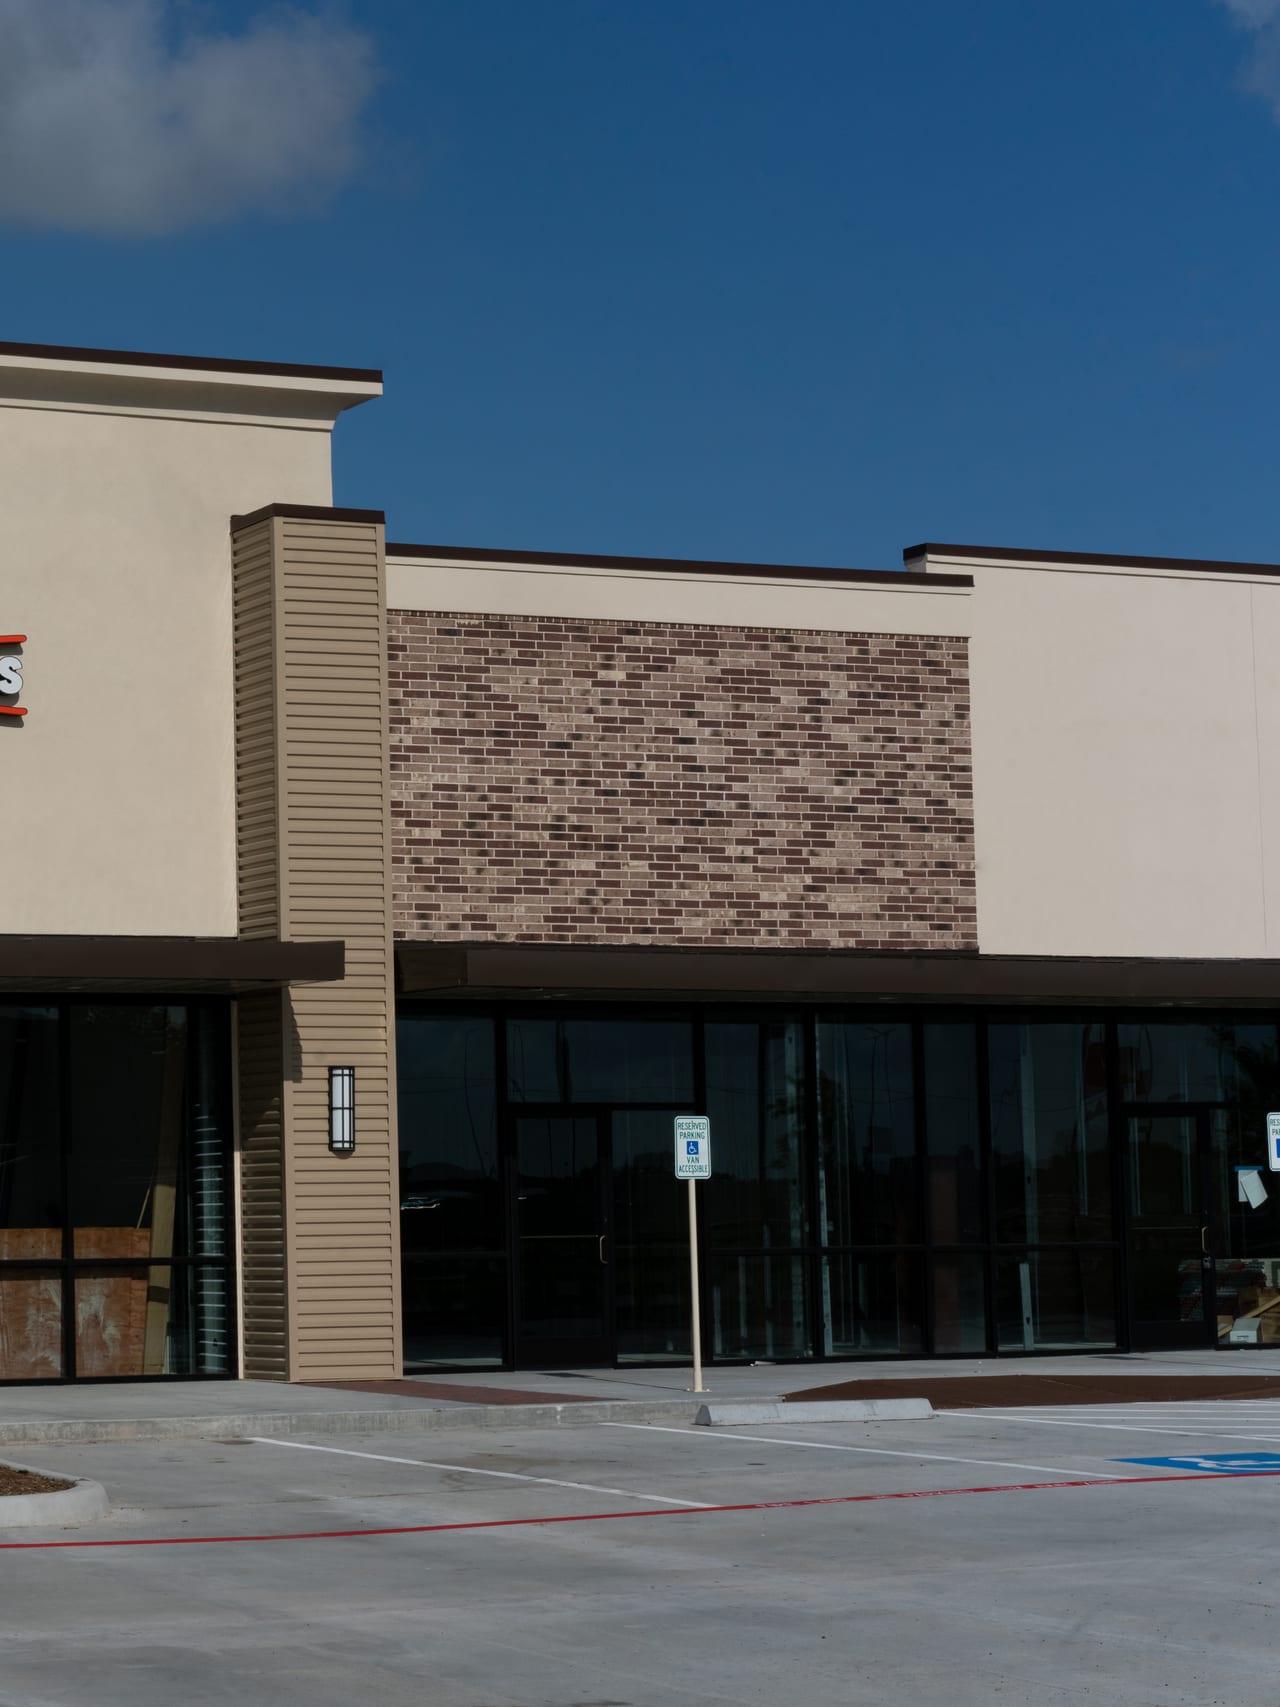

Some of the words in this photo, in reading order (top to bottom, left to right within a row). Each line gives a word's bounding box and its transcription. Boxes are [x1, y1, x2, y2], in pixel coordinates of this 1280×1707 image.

[677, 1122, 707, 1131] RESERVED
[680, 1131, 705, 1139] PARKING
[687, 1156, 700, 1164] VAN
[679, 1164, 708, 1173] ACCESSIBLE
